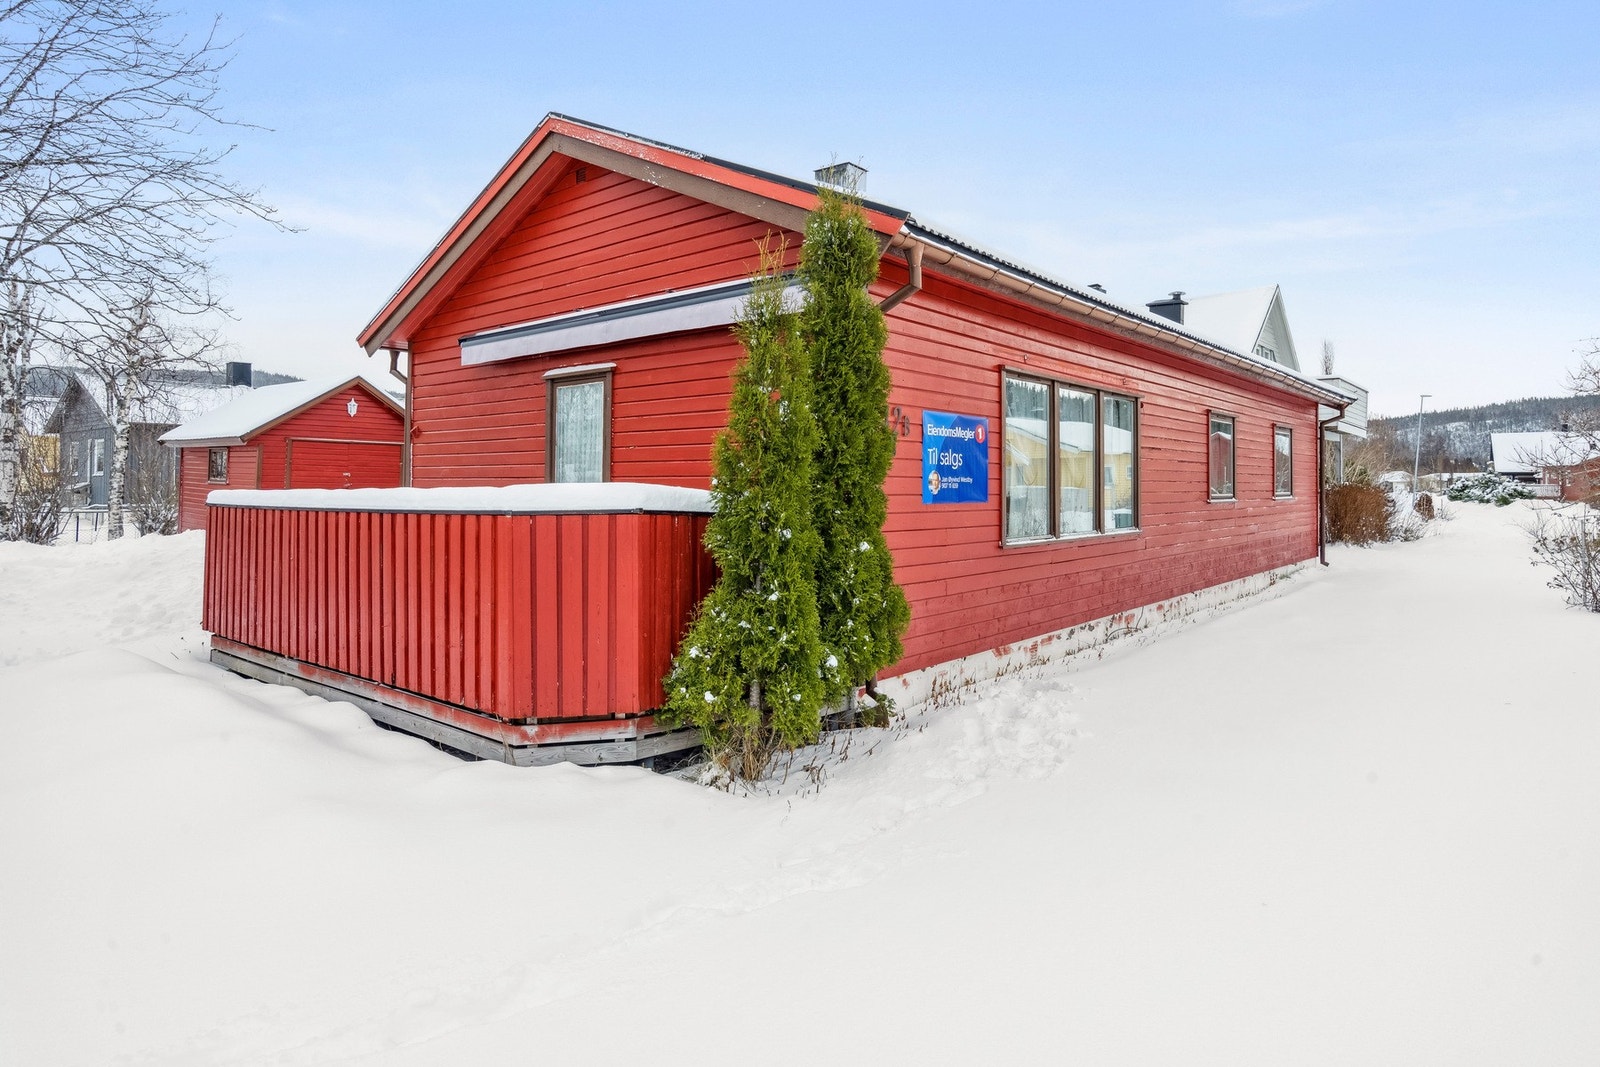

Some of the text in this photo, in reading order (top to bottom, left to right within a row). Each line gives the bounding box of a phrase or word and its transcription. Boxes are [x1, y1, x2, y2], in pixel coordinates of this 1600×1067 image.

[927, 424, 975, 441] EiendomsMegler
[927, 447, 963, 469] Til salgs
